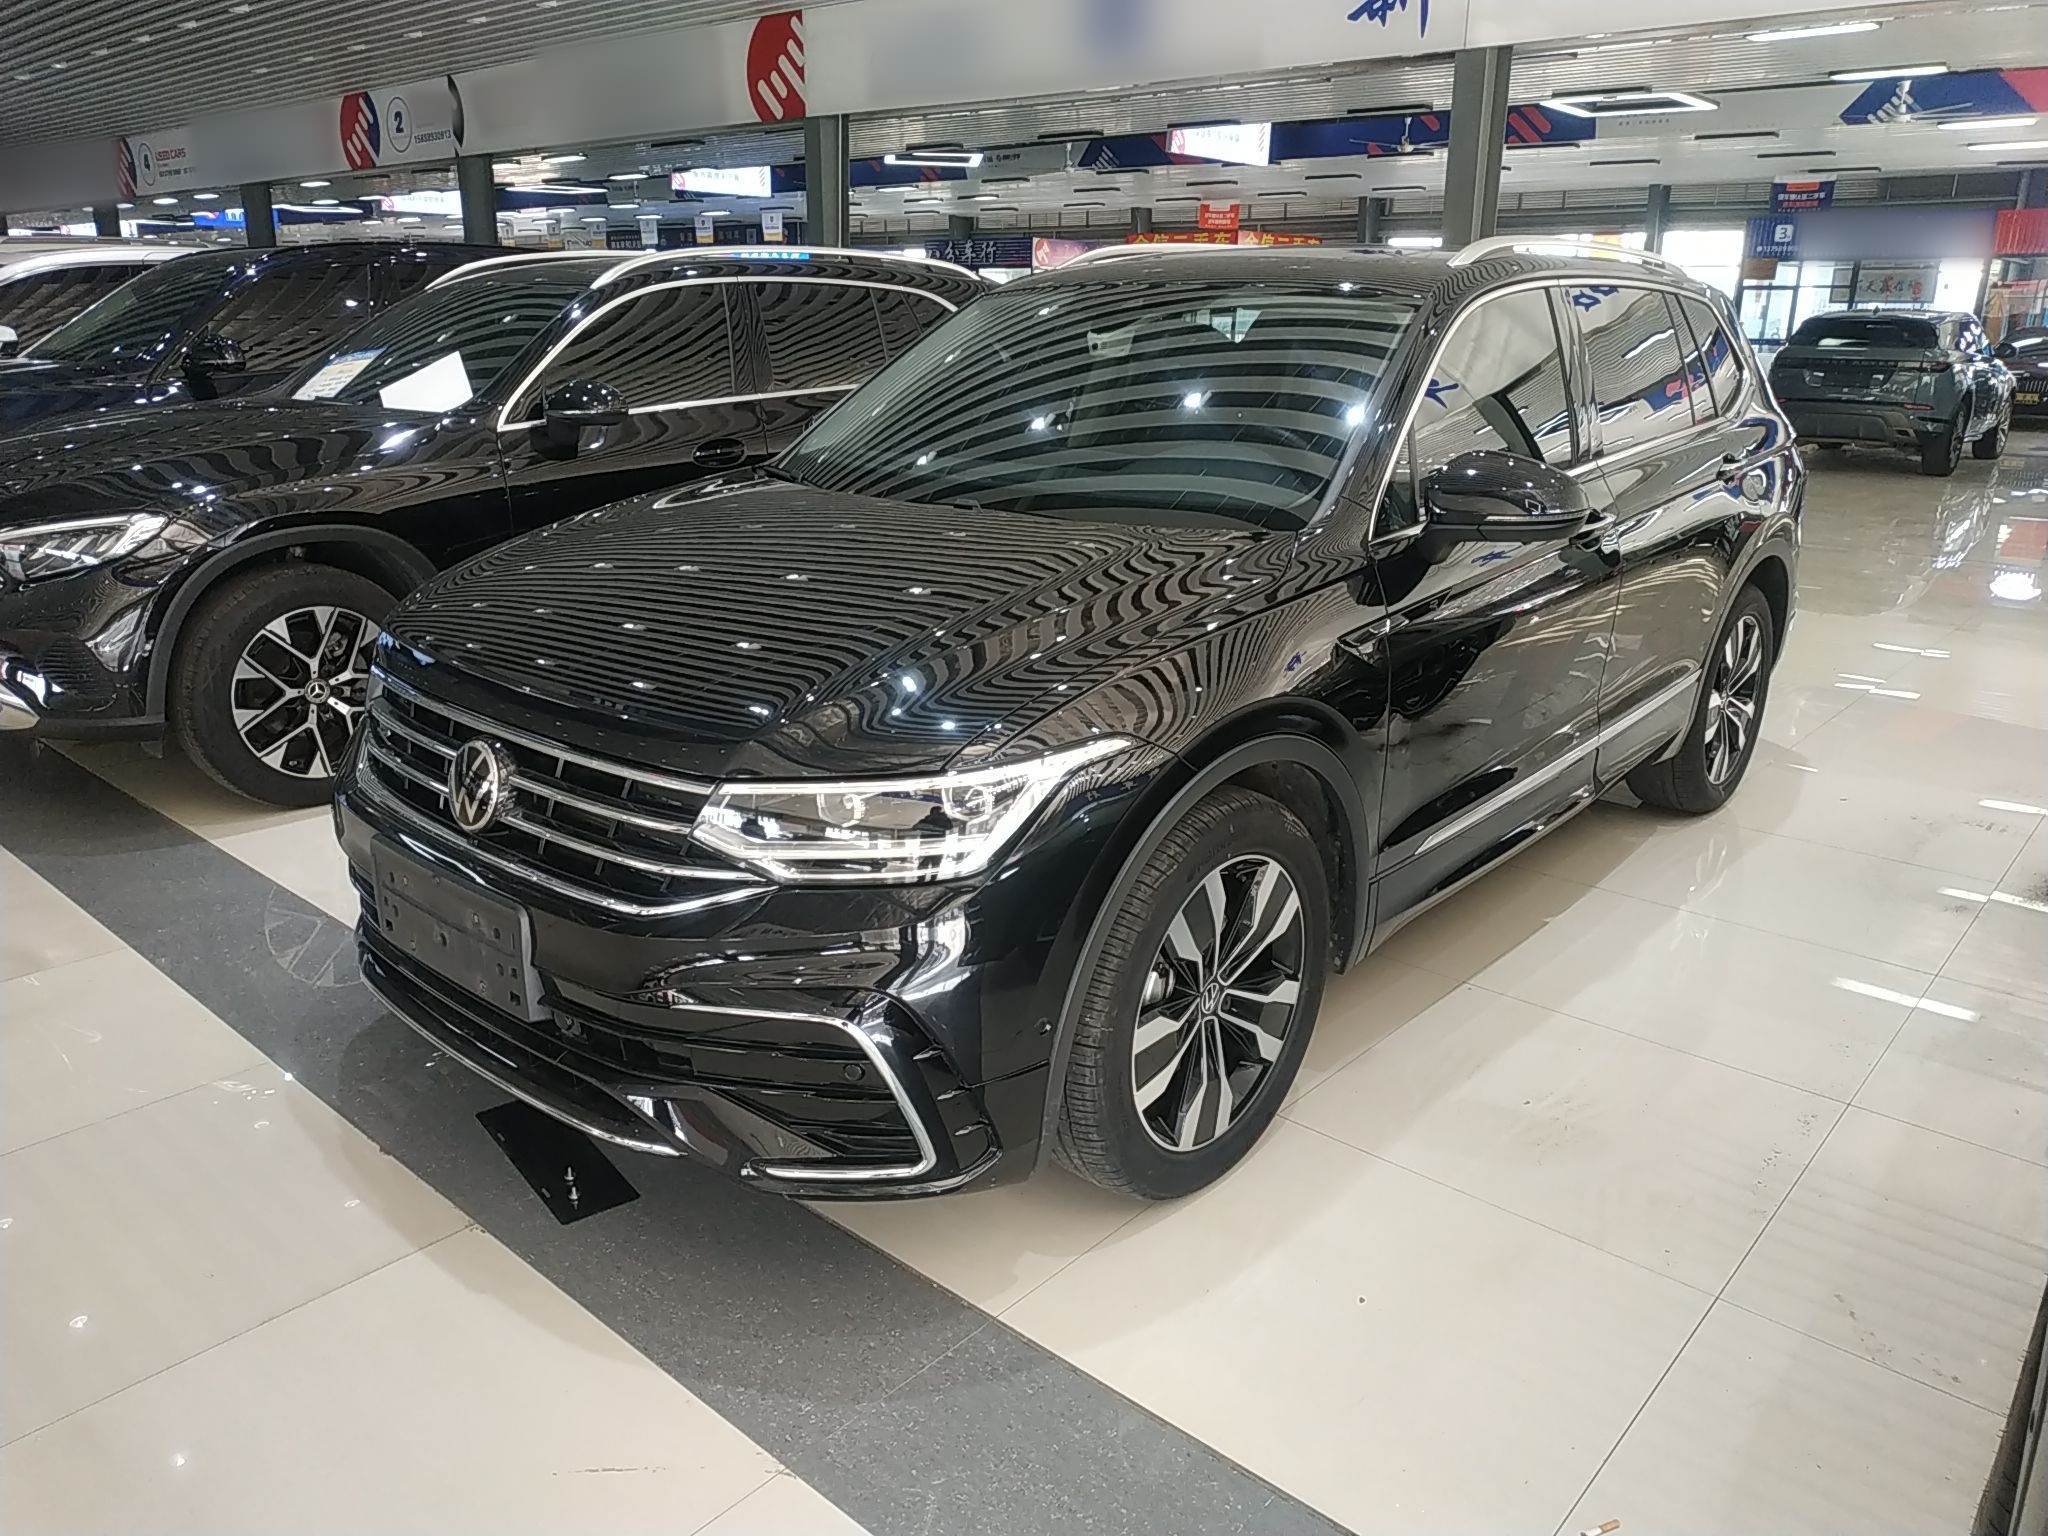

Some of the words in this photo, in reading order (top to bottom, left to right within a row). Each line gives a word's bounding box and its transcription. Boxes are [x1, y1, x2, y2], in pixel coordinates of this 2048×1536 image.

[393, 110, 404, 133] 2
[143, 153, 151, 171] 4
[155, 149, 171, 161] USED
[171, 147, 187, 159] CARS
[1778, 227, 1788, 240] 3
